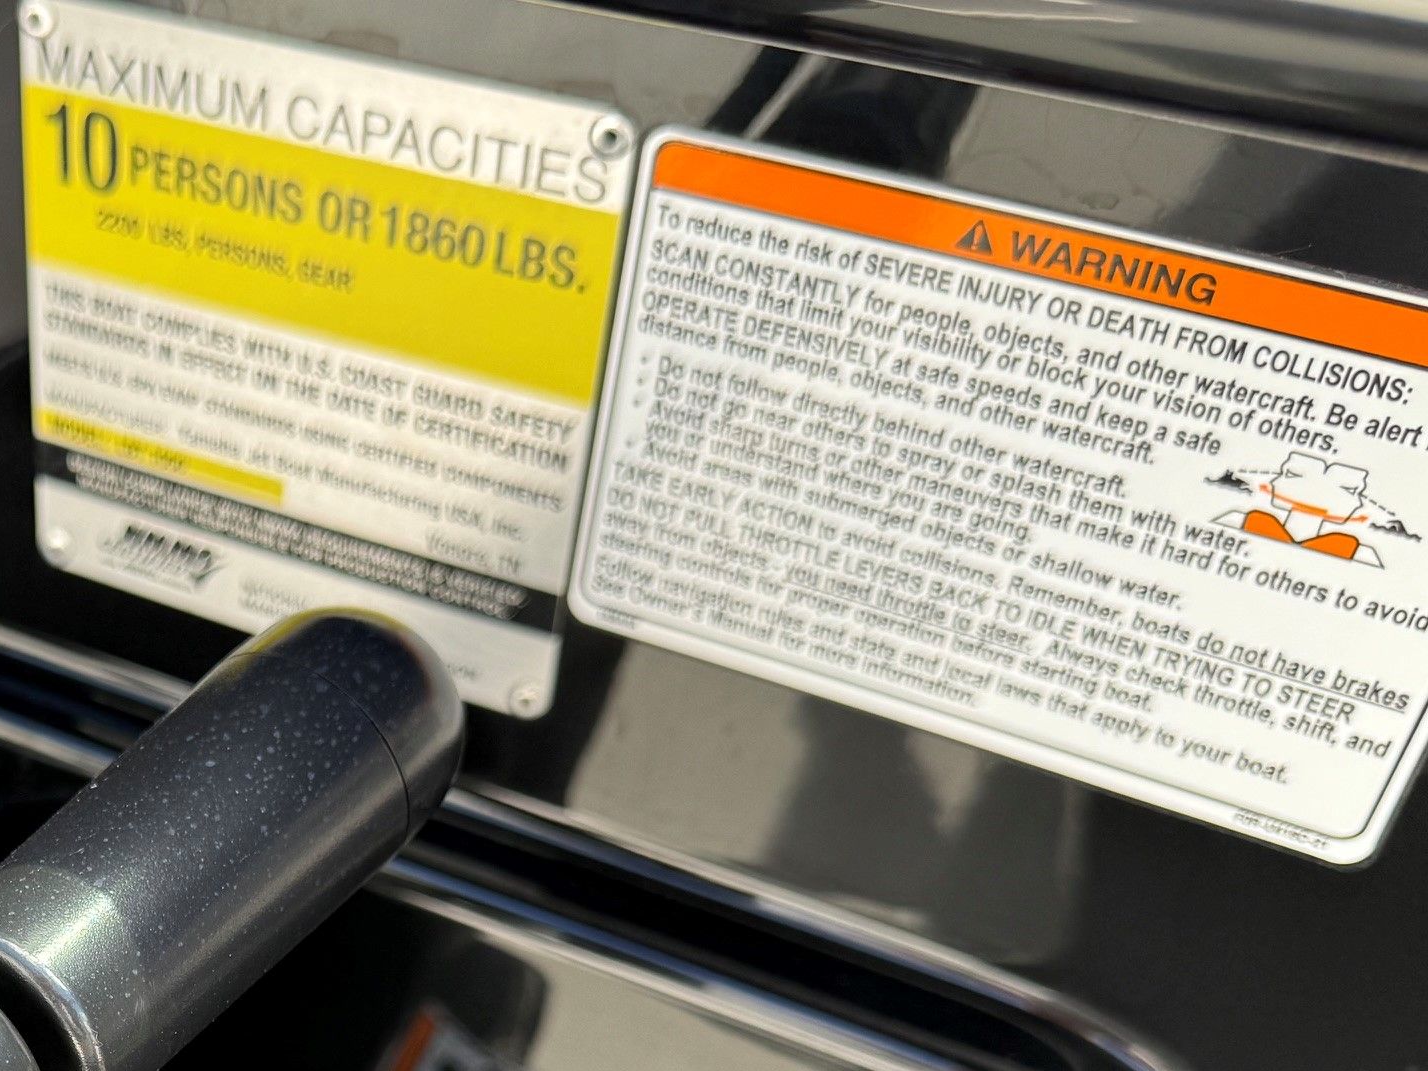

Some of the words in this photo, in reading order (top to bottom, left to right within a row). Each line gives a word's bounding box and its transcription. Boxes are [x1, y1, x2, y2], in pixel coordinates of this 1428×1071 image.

[35, 42, 267, 132] MAXIMUM
[286, 94, 611, 206] CAPACITIES
[44, 99, 117, 199] 10
[129, 144, 303, 227] PERSONS
[317, 188, 372, 244] OR
[381, 203, 487, 271] 1860
[494, 230, 587, 295] LBS.
[1006, 231, 1220, 306] WARNING
[640, 289, 738, 333] OPERATE
[741, 315, 890, 371] DEFENSIVELY
[890, 358, 912, 377] at
[914, 364, 959, 389] safe
[963, 377, 1042, 410] speeds
[1046, 398, 1091, 422] and
[1093, 405, 1149, 442] keep
[1153, 425, 1168, 442] a
[1172, 430, 1222, 456] safe
[645, 266, 749, 305] conditions
[754, 290, 795, 316] that
[798, 300, 843, 328] limit
[846, 316, 897, 342] your
[900, 328, 989, 370] visibility
[995, 353, 1021, 373] or
[1024, 356, 1089, 390] block
[1090, 377, 1147, 404] your
[1150, 390, 1222, 423] vision
[1226, 410, 1255, 431] of
[1257, 418, 1338, 453] others.
[649, 237, 709, 272] SCAN
[712, 253, 860, 309] CONSTANTLY
[862, 290, 895, 318] for
[897, 304, 973, 342] people,
[981, 322, 1068, 365] objects,
[1075, 347, 1122, 373] and
[1124, 358, 1189, 390] other
[1192, 376, 1316, 422] watercraft.
[1323, 403, 1360, 432] Be
[1363, 416, 1424, 447] alert
[656, 204, 681, 231] To
[685, 216, 753, 248] reduce
[757, 229, 789, 257] the
[793, 239, 833, 267] risk
[837, 250, 861, 273] of
[863, 253, 953, 295] SEVERE
[955, 275, 1044, 317] INJURY
[1045, 296, 1083, 326] OR
[1085, 305, 1171, 347] DEATH
[1172, 325, 1248, 365] FROM
[1250, 343, 1414, 405] COLLISIONS:
[411, 383, 482, 421] GUARD
[488, 404, 577, 447] SAFETY
[413, 413, 568, 475] CERTIFICATION
[636, 312, 717, 350] distance
[721, 334, 767, 363] from
[770, 352, 841, 387] people,
[848, 370, 926, 409] objects,
[932, 394, 975, 417] and
[978, 405, 1034, 433] other
[1038, 421, 1154, 465] watercraft.
[657, 355, 684, 381] Do
[688, 368, 722, 391] not
[725, 373, 786, 408] follow
[791, 391, 865, 433] directly
[873, 413, 944, 449] behind
[947, 437, 1006, 465] other
[1009, 454, 1125, 498] watercraft.
[649, 400, 704, 431] Avoid
[823, 452, 845, 470] or
[847, 459, 903, 486] other
[906, 475, 1023, 519] maneuvers
[1028, 506, 1071, 532] that
[1074, 521, 1135, 550] make
[1139, 535, 1157, 556] it
[1159, 541, 1212, 571] hard
[1215, 556, 1247, 581] for
[1253, 571, 1329, 603] others
[1333, 590, 1359, 612] to
[654, 377, 679, 401] Do
[683, 390, 718, 411] not
[720, 400, 747, 421] go
[751, 408, 795, 433] near
[800, 421, 865, 452] others
[869, 437, 890, 458] to
[895, 447, 956, 481] spray
[959, 465, 984, 484] or
[987, 472, 1063, 505] splash
[1067, 491, 1123, 521] them
[1128, 511, 1177, 536] with
[1180, 525, 1249, 556] water.
[821, 472, 882, 500] where
[885, 490, 925, 512] you
[929, 502, 964, 523] are
[802, 490, 915, 533] submerged
[918, 522, 996, 556] objects
[1001, 546, 1024, 564] or
[1028, 553, 1112, 589] shallow
[1118, 579, 1182, 610] water.
[991, 599, 1020, 624] TO
[1025, 609, 1076, 640] IDLE
[1079, 626, 1146, 661] WHEN
[1150, 647, 1236, 687] TRYING
[1238, 673, 1273, 698] TO
[1276, 684, 1358, 723] STEER
[1005, 575, 1123, 630] Remember,
[1130, 612, 1190, 645] boats
[1194, 630, 1224, 655] do
[1228, 644, 1268, 668] not
[1270, 652, 1327, 685] have
[1331, 670, 1410, 709] brakes
[1044, 639, 1120, 677] Always
[1123, 666, 1188, 697] check
[1193, 685, 1275, 727] throttle,
[1283, 714, 1337, 746] shift,
[1346, 733, 1391, 757] and
[1089, 711, 1148, 744] apply
[1152, 728, 1175, 748] to
[1178, 739, 1229, 765] your
[1234, 752, 1287, 784] boat.
